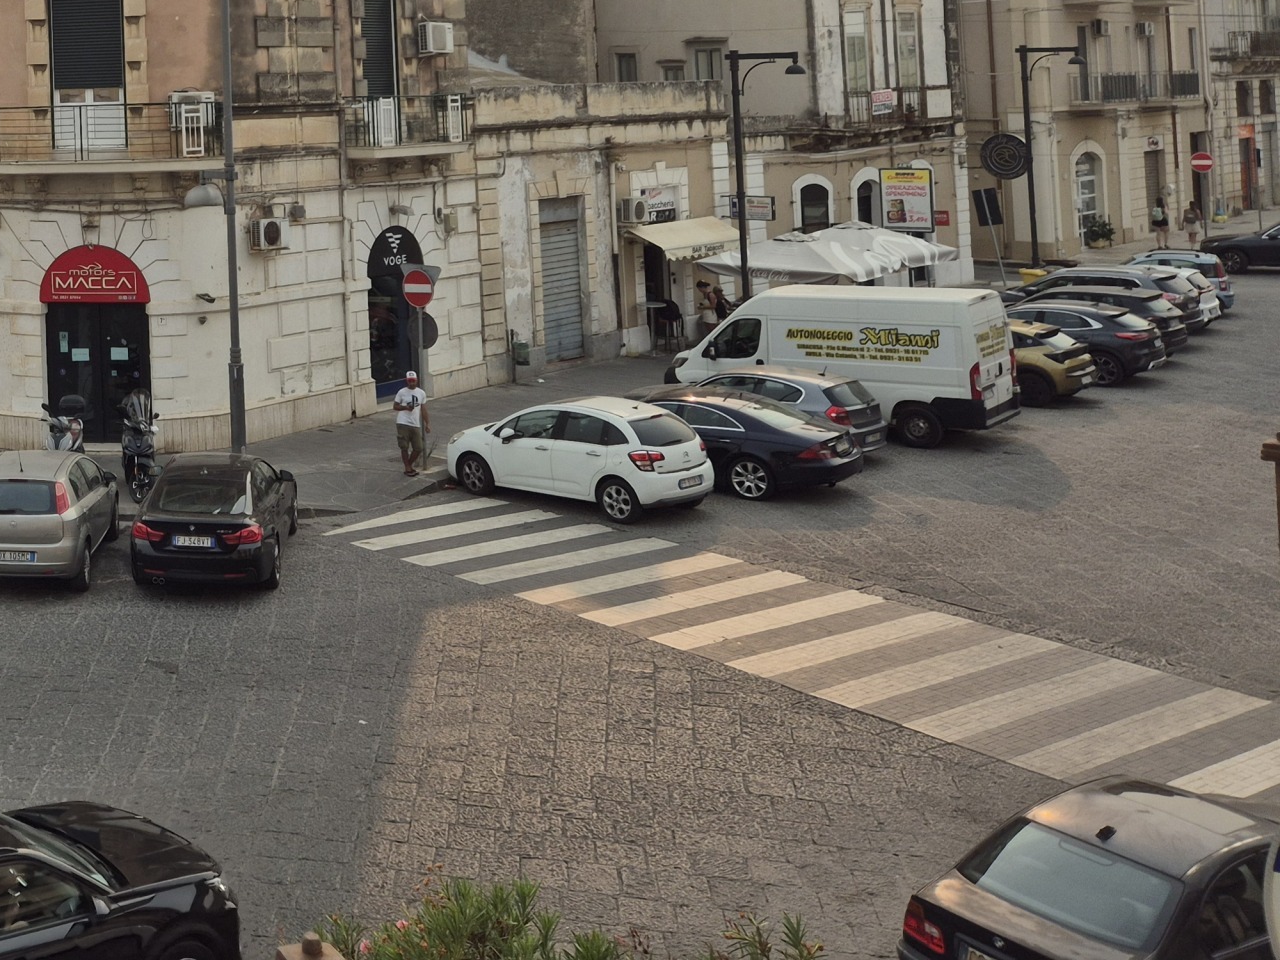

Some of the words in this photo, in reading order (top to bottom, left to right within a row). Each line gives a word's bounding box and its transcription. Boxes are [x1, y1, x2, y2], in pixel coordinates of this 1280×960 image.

[692, 246, 702, 254] BAR
[383, 254, 407, 266] VOGE
[68, 268, 116, 276] motors
[55, 276, 133, 289] MACCA
[786, 328, 853, 341] AUTONOLEGGIO
[176, 536, 186, 545] FJ
[9, 551, 30, 561] 105MC
